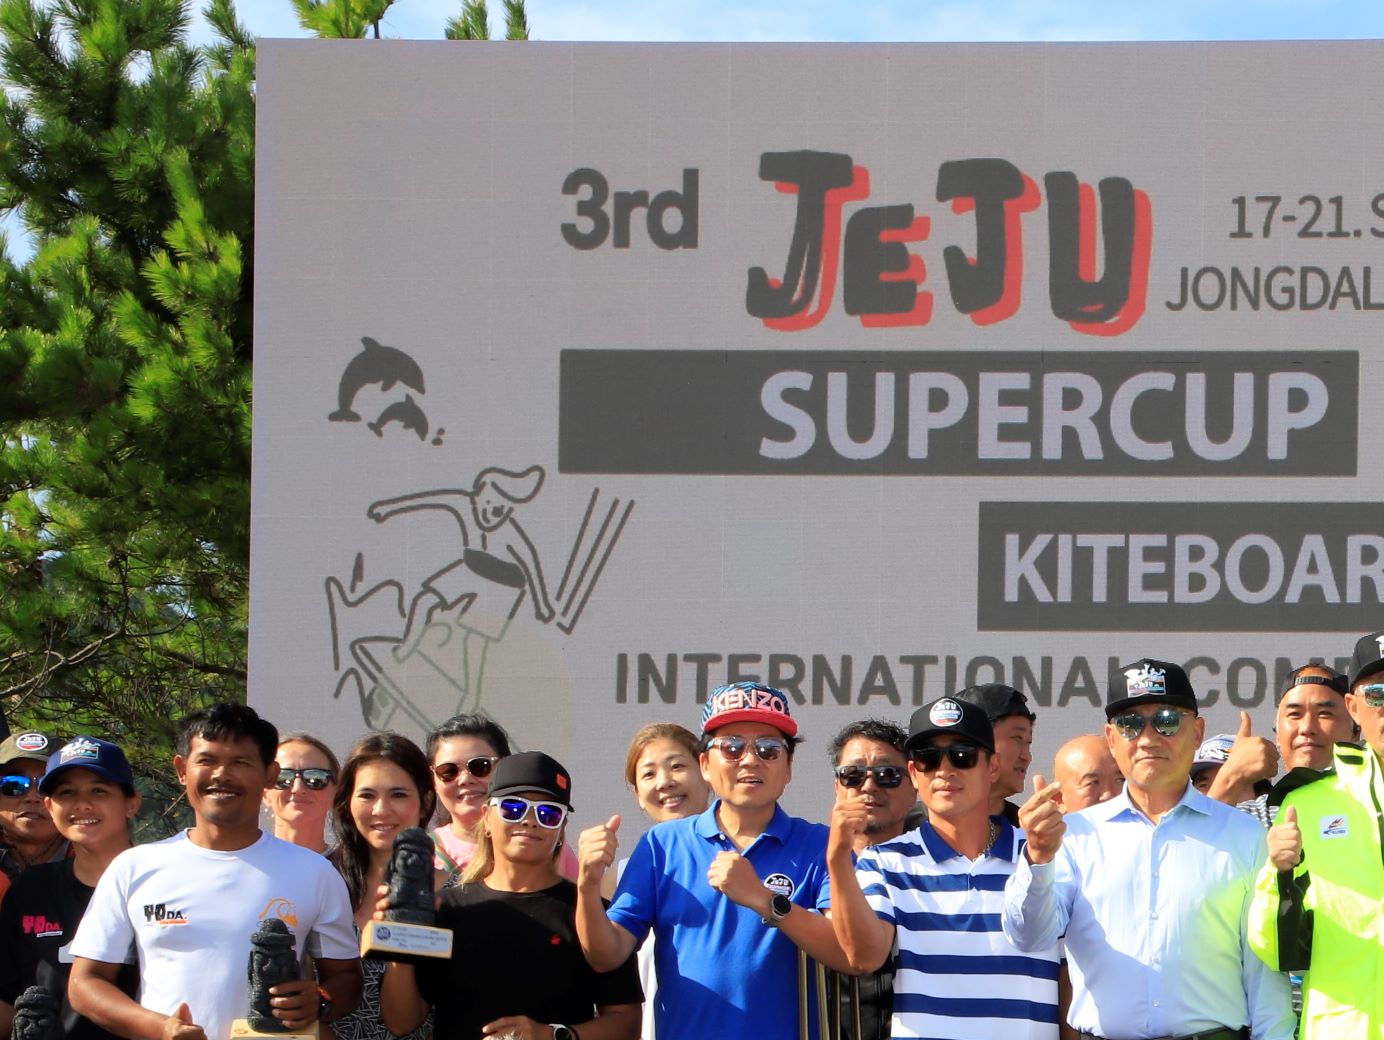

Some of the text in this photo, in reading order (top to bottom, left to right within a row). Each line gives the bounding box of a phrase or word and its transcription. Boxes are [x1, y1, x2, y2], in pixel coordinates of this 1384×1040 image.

[561, 168, 699, 250] 3rd
[758, 371, 1329, 461] SUPERCUP
[615, 652, 1125, 708] INTERNATIONA
[712, 689, 785, 715] KENZO
